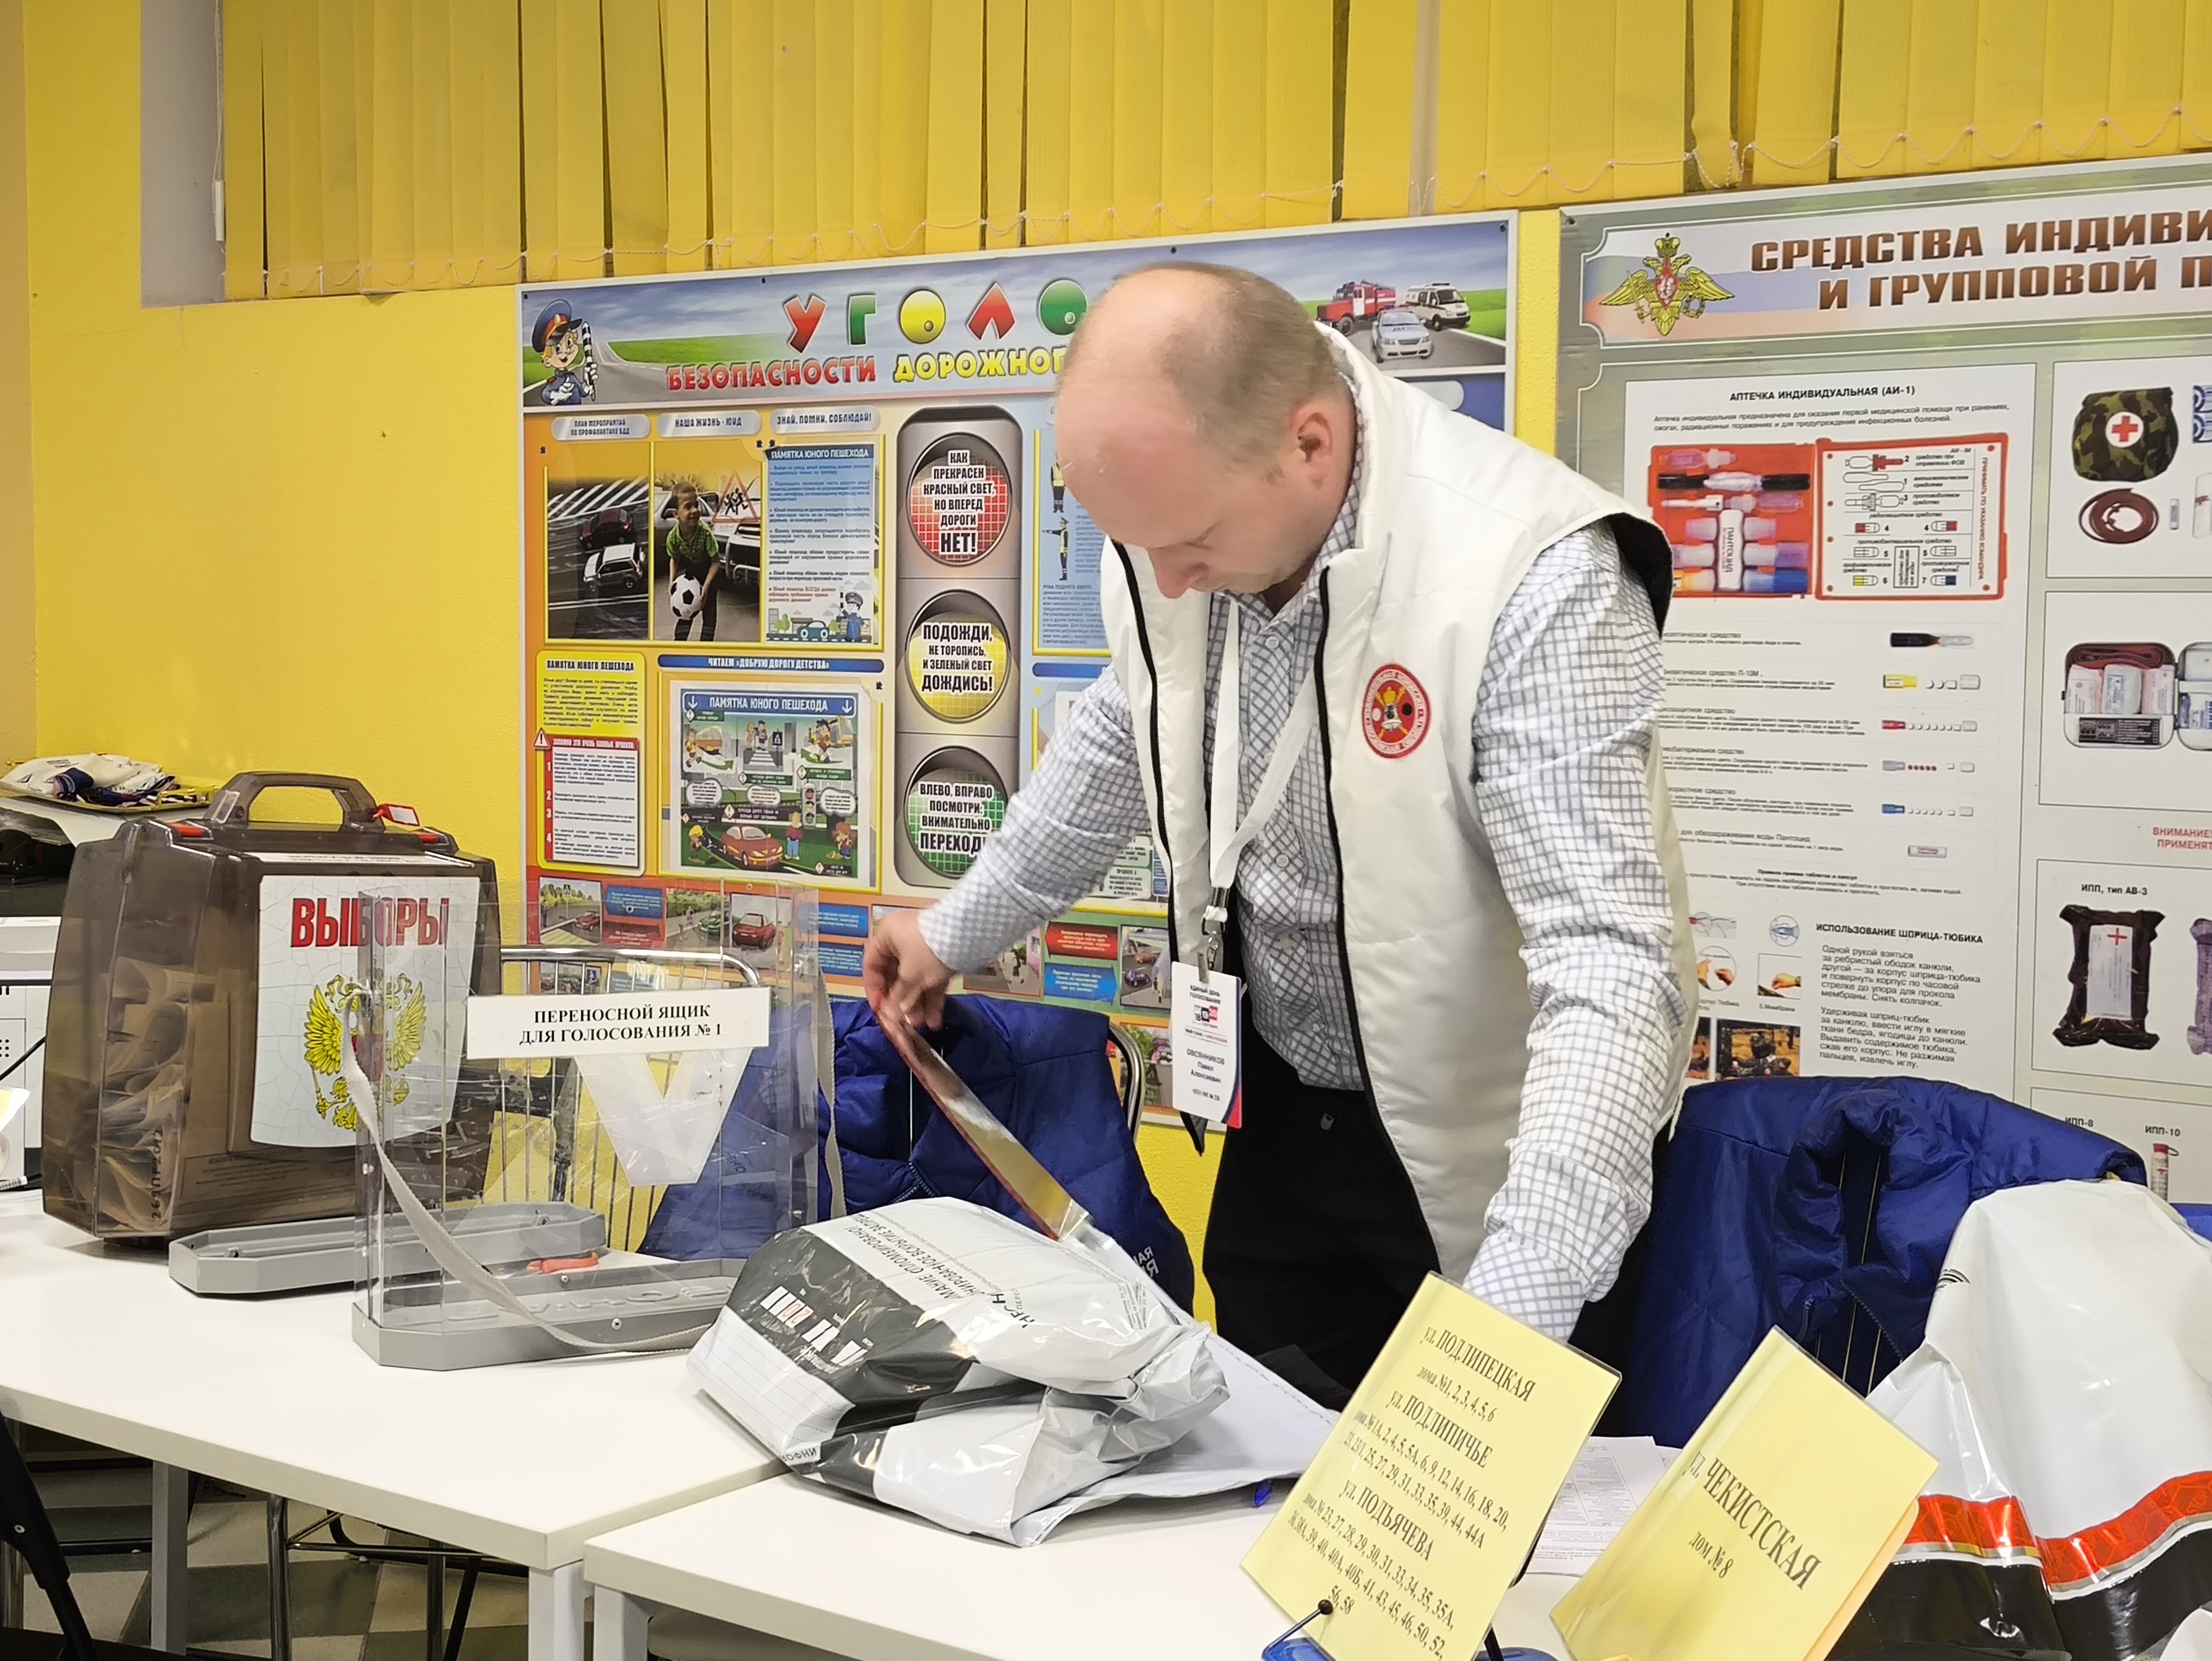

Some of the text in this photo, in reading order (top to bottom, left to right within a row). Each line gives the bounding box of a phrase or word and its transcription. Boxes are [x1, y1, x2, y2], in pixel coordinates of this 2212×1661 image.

[1751, 210, 2212, 272] СРЕДСТВА ИНДИВИ
[1819, 279, 1848, 310] И
[1869, 259, 2157, 307] ГРУППОВОЙ
[667, 355, 877, 391] БЕЗОПАСНОСТИ
[1730, 386, 1915, 401] АПТЕЧКА ИНДИВИДУАЛЬНАЯ (АИ-1)
[675, 417, 742, 427] НАША ЖИЗНЬ ЮИД
[776, 413, 871, 425] ЗНАЙ, ПОМНИ, СОБЛЮДАЙ!
[771, 449, 869, 459] ПАМЯТКА ЮНОГО ПЕШЕХОДА
[950, 453, 968, 464] КАК
[934, 467, 984, 479] ПРЕКРАСЕН
[924, 482, 995, 495] КРАСНЫЙ СВЕТ,
[934, 499, 983, 511] НО ВПЕРЕД
[940, 514, 976, 527] ДОРОГИ
[941, 532, 976, 553] НЕТ!
[923, 624, 994, 642] ПОДОЖДИ,
[929, 645, 986, 656] НЕ ТОРОПИСЬ,
[547, 660, 634, 671] ПАМЯТКА ЮНОГО ПЕШЕХОДА
[708, 657, 830, 669] ЧИТАЕМ «ДОБРУЮ ДОРОГУ ДЕТСТВА»
[923, 659, 992, 671] И ЗЕЛЕНЫЙ СВЕТ
[922, 675, 993, 693] ДОЖДИСЬ!
[709, 697, 828, 712] ПАМЯТКА ЮНОГО ПЕШЕХОДА
[920, 784, 992, 798] ВЛЕВО, ВПРАВО
[929, 800, 983, 814] ПОСМОТРИ:
[922, 815, 990, 830] ВНИМАТЕЛЬНО
[2153, 827, 2212, 838] ВНИМАНИЕ
[920, 833, 985, 853] ПЕРЕХОД
[2081, 884, 2103, 894] ИПП,
[2125, 886, 2147, 896] АВ-3
[290, 897, 450, 948] ВЫБОРЫ
[1816, 924, 1983, 943] ИСПОЛЬЗОВАНИЕ ШПРИЦА-ТЮБИКА
[1822, 944, 1913, 959] Одной рукой взяться
[1834, 955, 1881, 965] ребристый
[1884, 959, 1916, 969] ободок
[1919, 963, 1954, 973] канюли,
[1821, 964, 1851, 972] другой
[1877, 969, 1907, 978] корпус
[1910, 972, 1981, 983] шприца-тюбика
[1830, 974, 1874, 984] повернуть
[1876, 977, 1907, 987] корпус
[1923, 982, 1959, 990] часовой
[1821, 981, 1855, 990] стрелке
[1871, 986, 1897, 995] упора
[1918, 990, 1955, 999] прокола
[1821, 990, 1942, 1007] мембраны. Снять колпачок.
[534, 1004, 711, 1023] ПЕРЕНОСНОЙ ЯЩИК
[1821, 1007, 1930, 1024] Удерживая шприц-тюбик
[519, 1023, 721, 1046] ДЛЯ ГОЛОСОВАНИЯ № 1
[1833, 1018, 1869, 1028] канюлю,
[1871, 1021, 1902, 1030] ввести
[1904, 1025, 1924, 1034] иглу
[1935, 1028, 1966, 1037] мягкие
[1847, 1027, 1876, 1037] бедра,
[1879, 1031, 1915, 1041] ягодицы
[1932, 1037, 1968, 1045] канюли.
[1198, 1062, 1214, 1071] Павел
[2145, 1126, 2180, 1137] ИПП-10
[1420, 1327, 1536, 1402] ул. ПОДЛИПЕЦКАЯ
[1417, 1367, 1497, 1422] дома №1, 2, 3, 4, 5, 6
[1385, 1391, 1493, 1468] ул. ПОДЛИПИЧЬЕ
[1344, 1431, 1485, 1549] 23, 23/1, 25, 27, 29, 31, 33, 35, 39, 44, 44А
[1338, 1479, 1434, 1561] ул. ПОДЪЯЧЕВА
[1682, 1451, 1706, 1479] ул.
[1703, 1457, 1822, 1590] ЧЕКИСТСКАЯ
[1688, 1531, 1713, 1559] дом
[1719, 1558, 1735, 1578] 8
[1327, 1587, 1355, 1615] 56, 58
